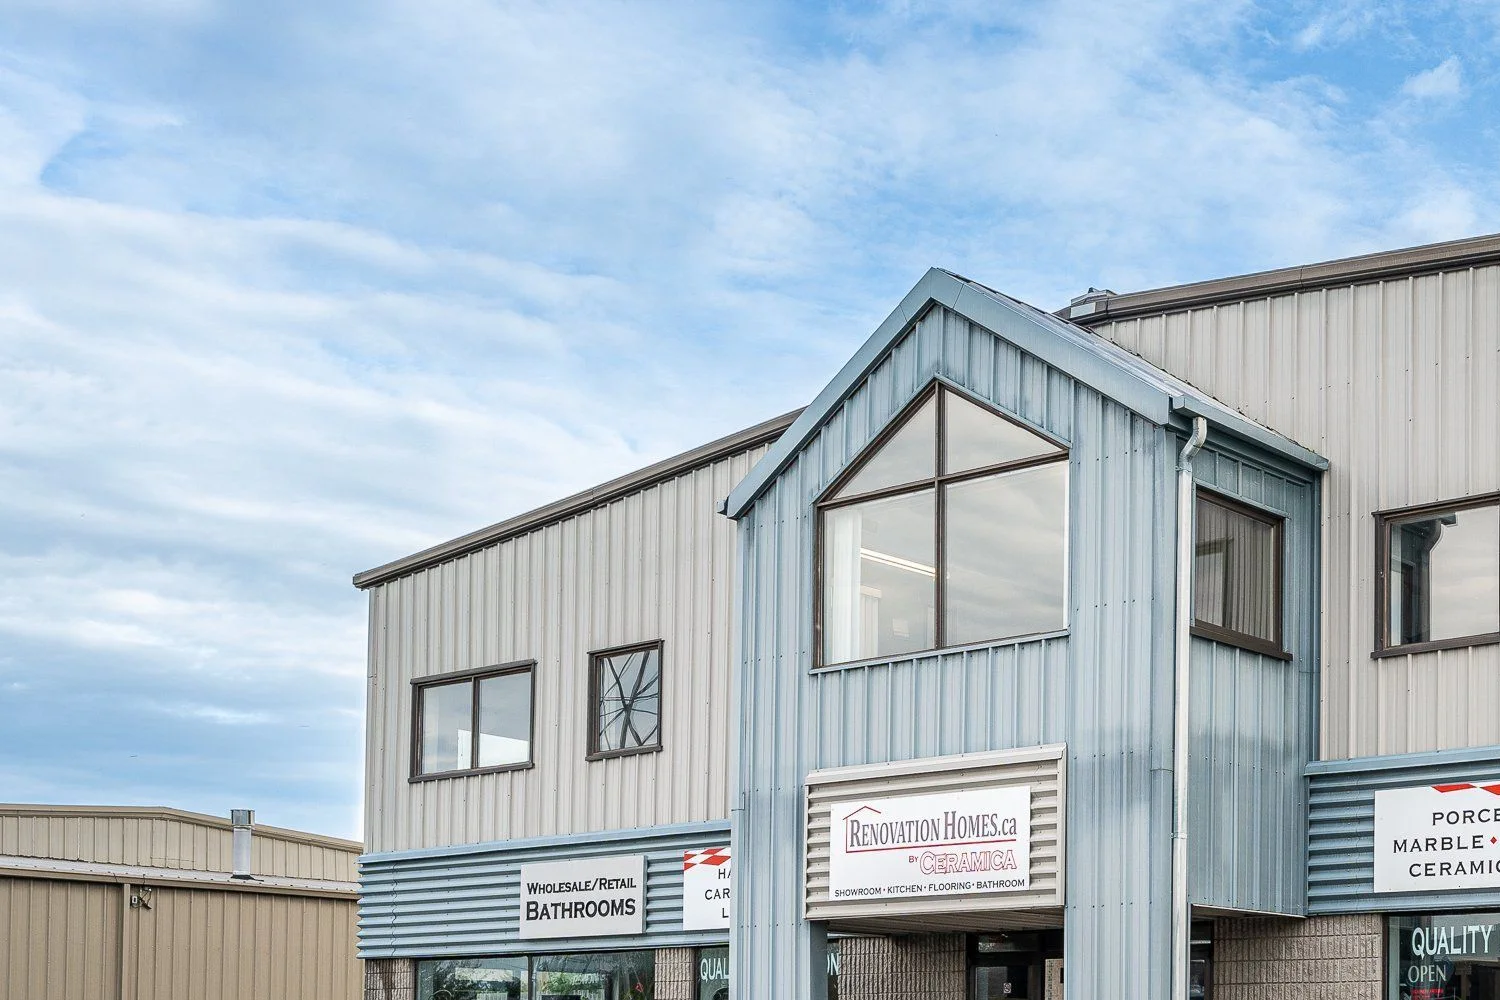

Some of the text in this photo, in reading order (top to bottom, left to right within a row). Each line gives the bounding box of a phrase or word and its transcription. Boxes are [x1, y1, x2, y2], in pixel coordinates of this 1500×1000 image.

[849, 810, 1017, 848] RENOVATION HOMES.ca
[1393, 834, 1484, 853] MARBLE
[908, 855, 919, 864] BY
[919, 849, 1017, 875] CERAMICA
[526, 877, 636, 895] WHOLESALE/RETAIL
[704, 887, 730, 901] CAR
[834, 879, 1025, 897] SHOWROOM KITCHEN FLOORING BATHROOM
[525, 898, 636, 921] BATHROOMS
[1411, 924, 1494, 960] QUALITY
[700, 957, 730, 983] QUAL
[1407, 964, 1447, 983] OPEN
